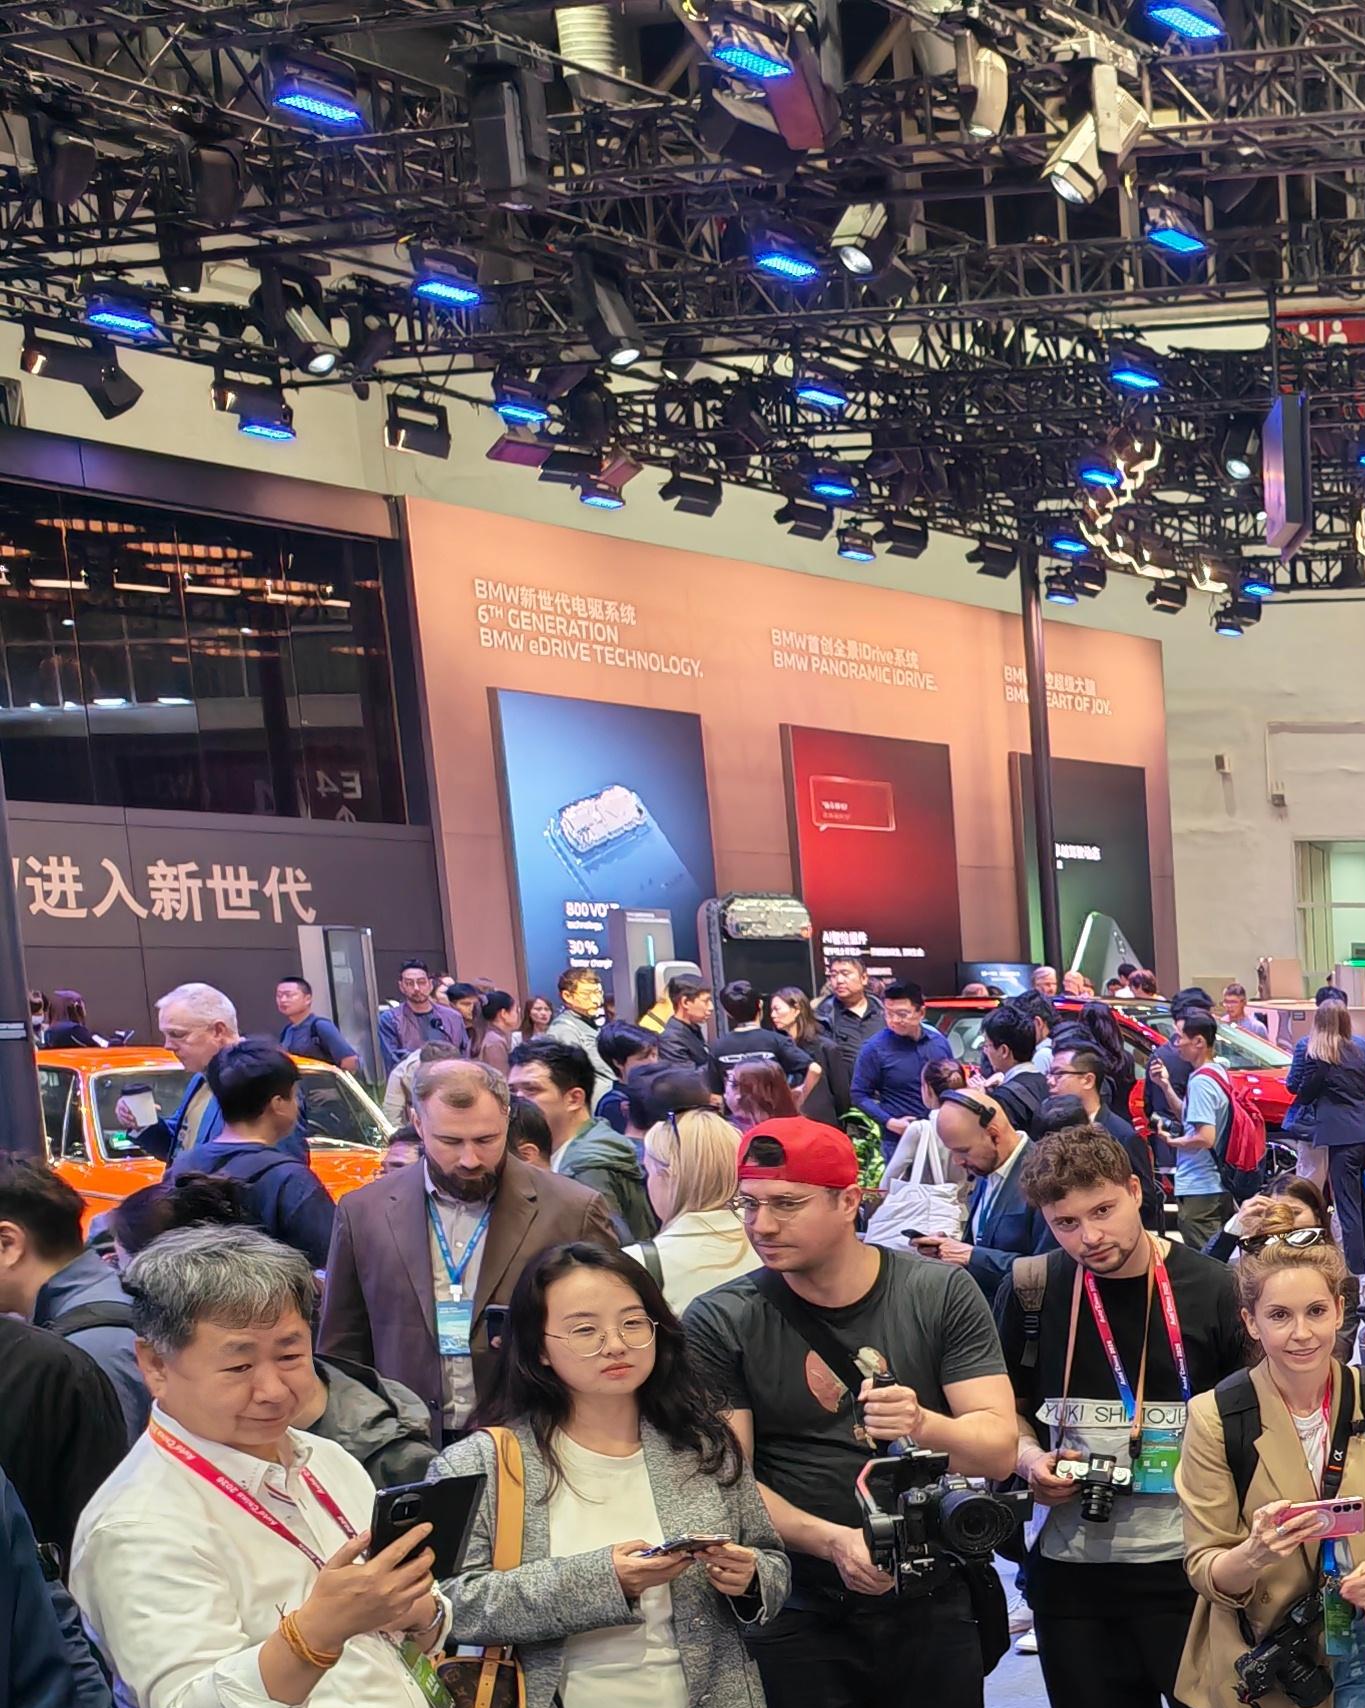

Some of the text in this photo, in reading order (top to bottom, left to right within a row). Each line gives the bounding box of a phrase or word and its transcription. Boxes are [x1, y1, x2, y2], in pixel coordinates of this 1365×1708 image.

[478, 604, 619, 644] 6TH GENERATION
[479, 628, 704, 678] BMW eDRIVE TECHNOLOGY.
[773, 651, 808, 671] BMW
[811, 655, 892, 685] PANORAMIC
[1047, 690, 1074, 711] EART
[1074, 697, 1091, 712] OF
[12, 855, 317, 923] 进入新世代
[1044, 1403, 1085, 1421] YUKI
[215, 1475, 278, 1526] Auto China 2026
